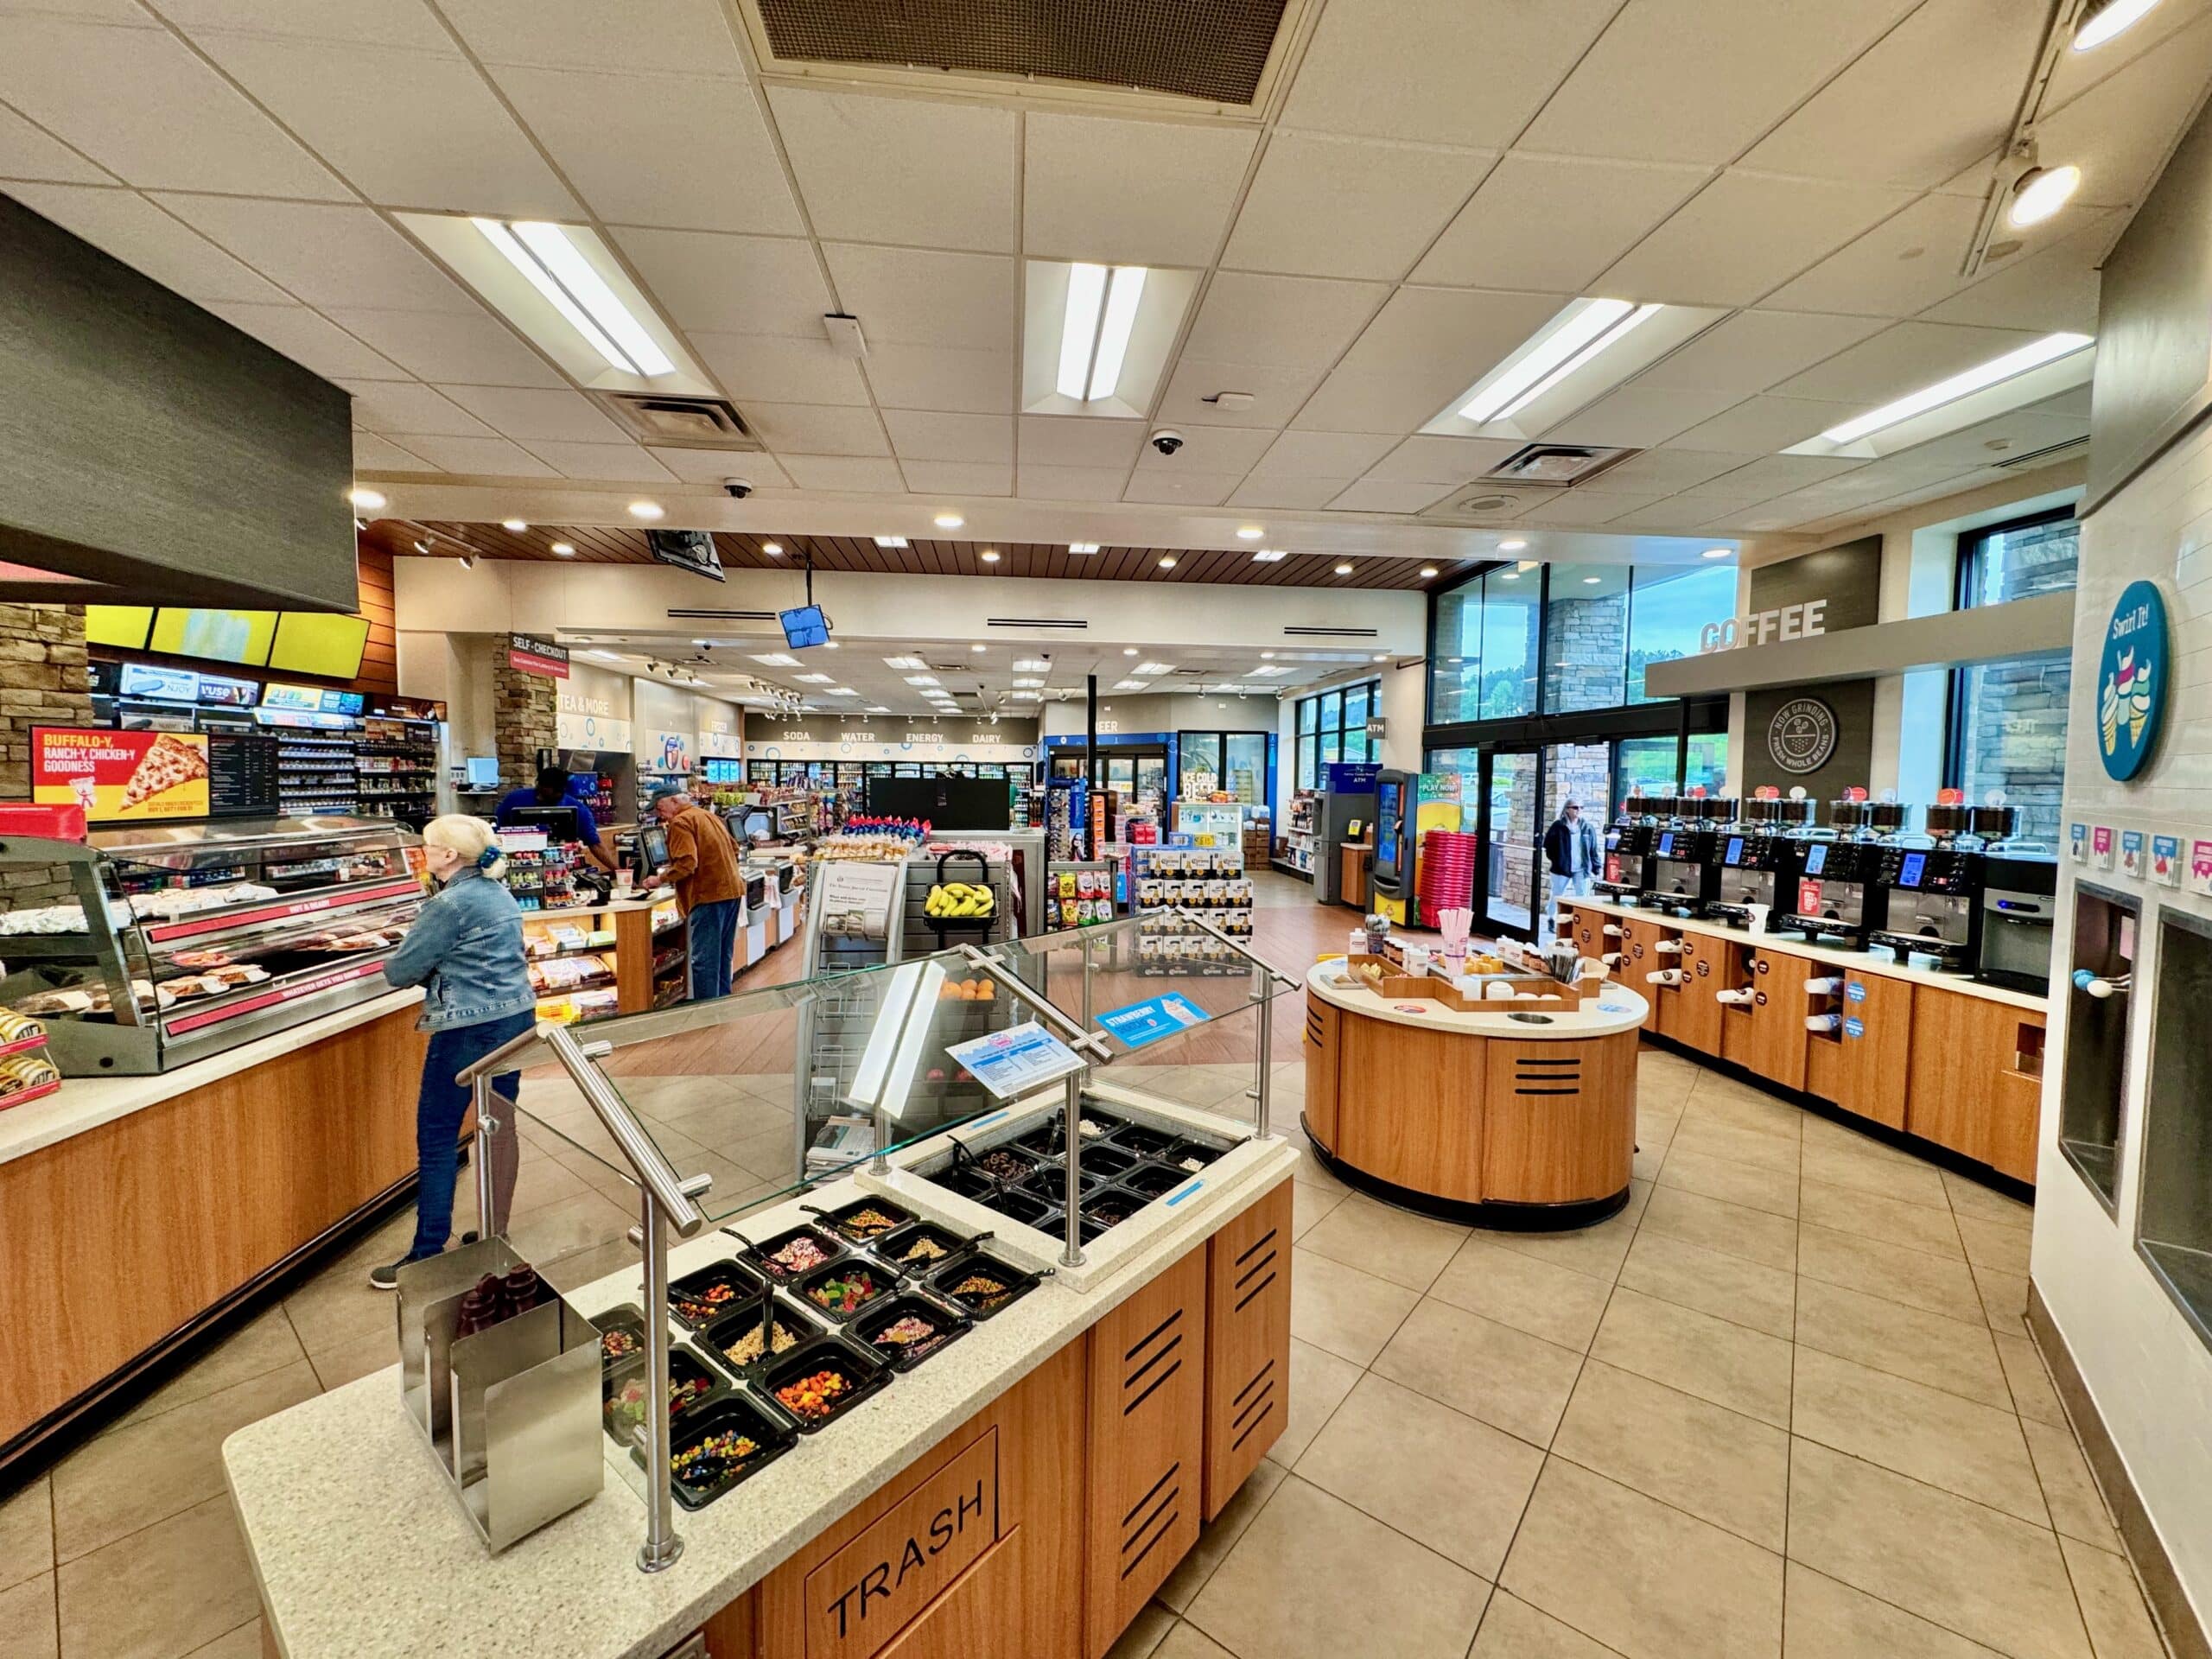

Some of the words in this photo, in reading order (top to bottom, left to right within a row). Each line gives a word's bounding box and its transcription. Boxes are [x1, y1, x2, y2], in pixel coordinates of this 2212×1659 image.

[1700, 599, 1827, 654] COFFEE
[2113, 609, 2137, 639] Swirl
[2137, 603, 2149, 629] It!
[512, 636, 531, 650] SELF
[534, 642, 567, 659] CHECKOUT
[577, 696, 584, 712] &
[585, 698, 608, 715] MORE
[1774, 709, 1791, 730] NOW
[1791, 703, 1828, 727] GRINDING
[1096, 721, 1118, 732] EER
[1367, 723, 1384, 733] ATM
[44, 734, 114, 749] BUFFALO-Y,
[783, 731, 810, 741] SODA
[841, 732, 875, 741] WATER
[906, 733, 944, 742] ENERGY
[972, 734, 1001, 744] DAIRY
[44, 747, 88, 760] RANCH-Y,
[90, 749, 136, 760] CHICKEN-Y
[1772, 736, 1787, 761] FRESH
[1786, 757, 1812, 767] WHOLE
[1812, 734, 1829, 761] BEANS
[44, 760, 95, 772] GOODNESS
[1183, 772, 1195, 783] ICE
[1196, 772, 1217, 783] COLD
[283, 982, 316, 997] WHATEVER
[1106, 1006, 1155, 1027] STRAWBERRY
[827, 1479, 982, 1639] TRASH
